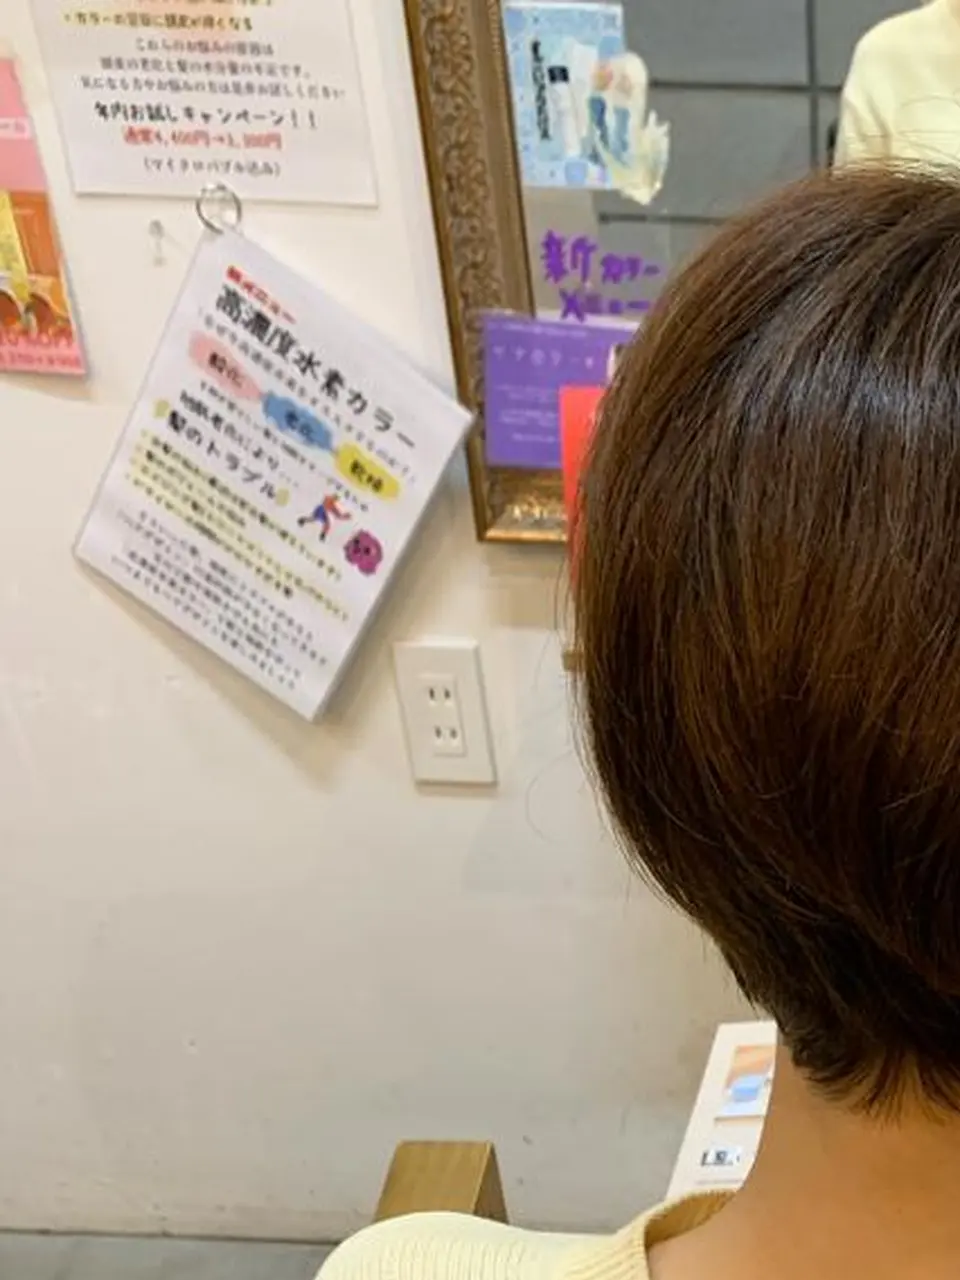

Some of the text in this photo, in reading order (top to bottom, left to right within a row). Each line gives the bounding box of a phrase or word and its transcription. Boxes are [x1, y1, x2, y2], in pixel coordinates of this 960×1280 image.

[212, 282, 421, 452] 高濃度水素カラー
